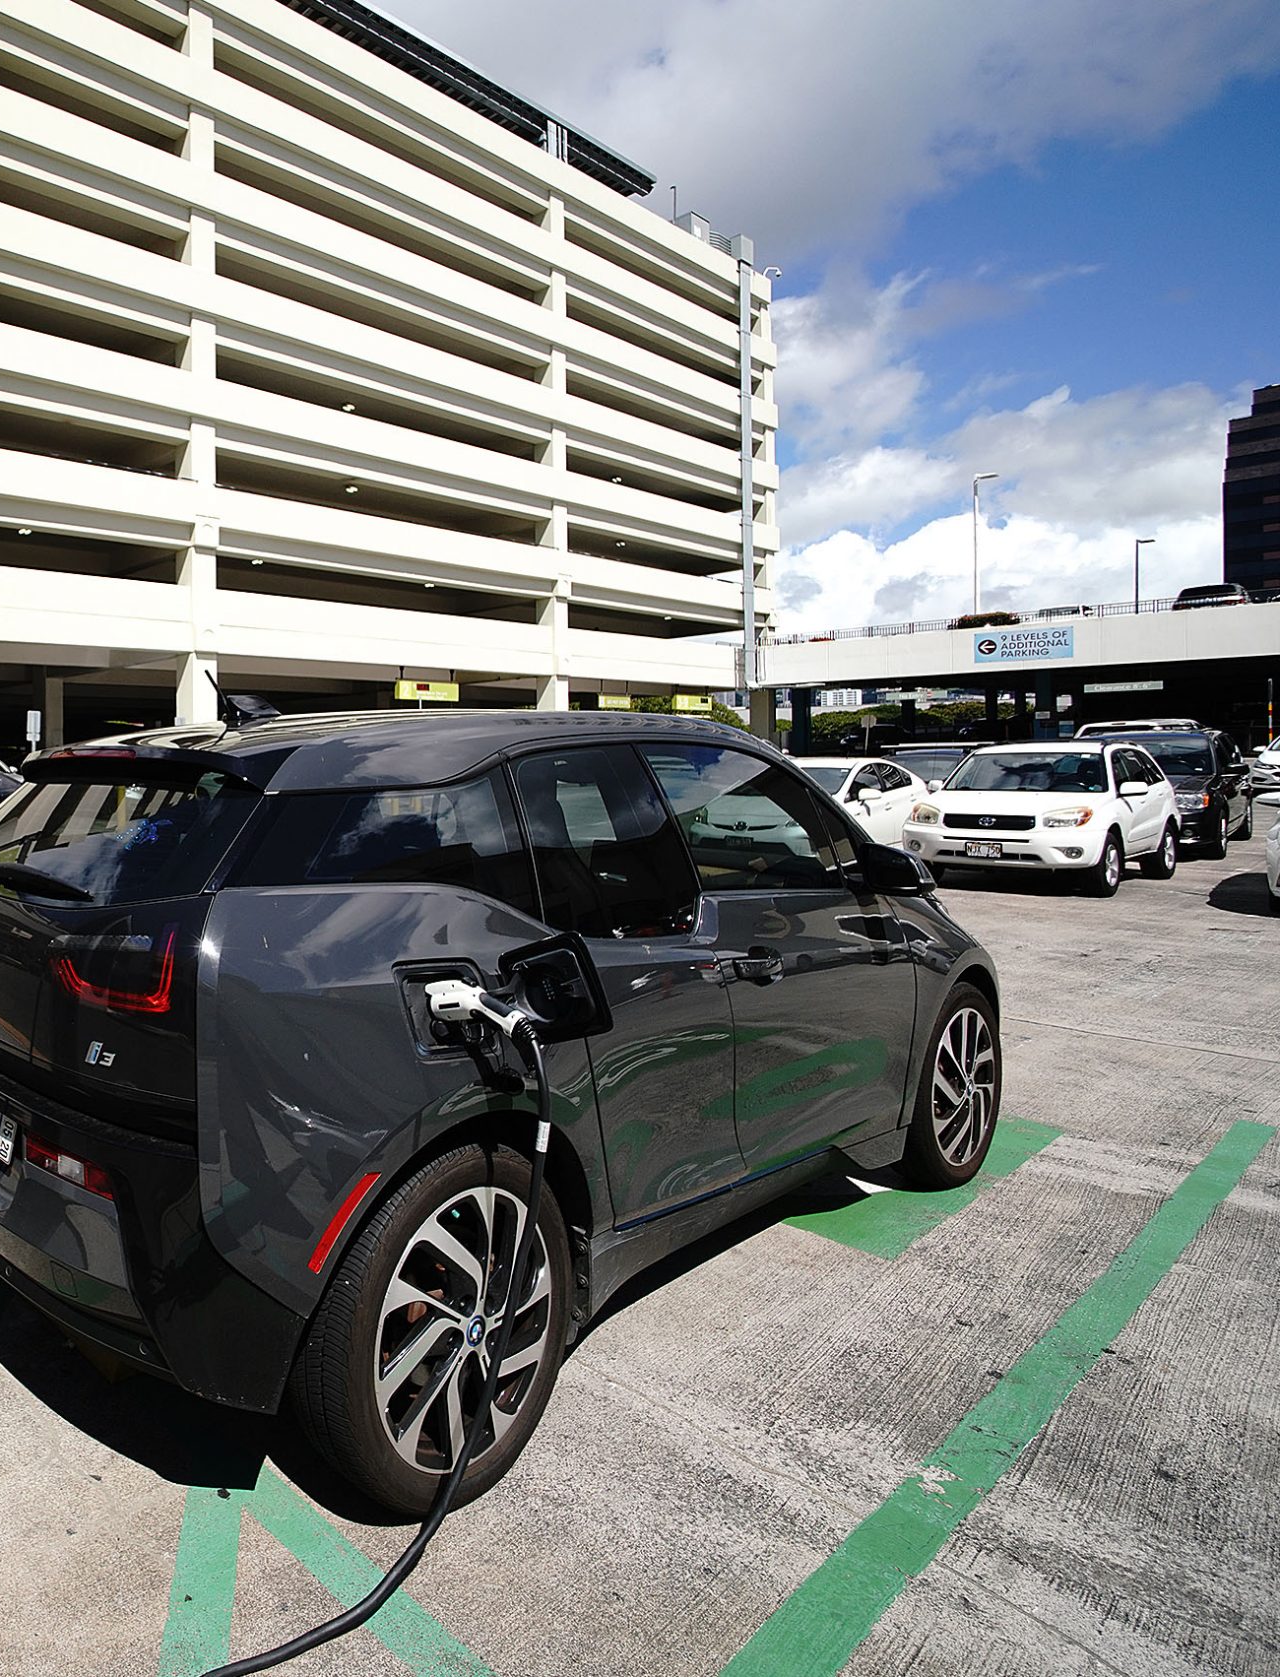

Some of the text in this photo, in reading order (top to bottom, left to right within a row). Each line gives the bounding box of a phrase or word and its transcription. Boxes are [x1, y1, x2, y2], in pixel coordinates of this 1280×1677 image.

[1000, 630, 1068, 642] 9 LEVELS OF
[1000, 638, 1070, 650] ADDITIONAL
[1000, 647, 1050, 658] PARKING
[85, 1041, 116, 1067] i3
[3, 1120, 14, 1140] 05
[0, 1140, 10, 1159] 20
